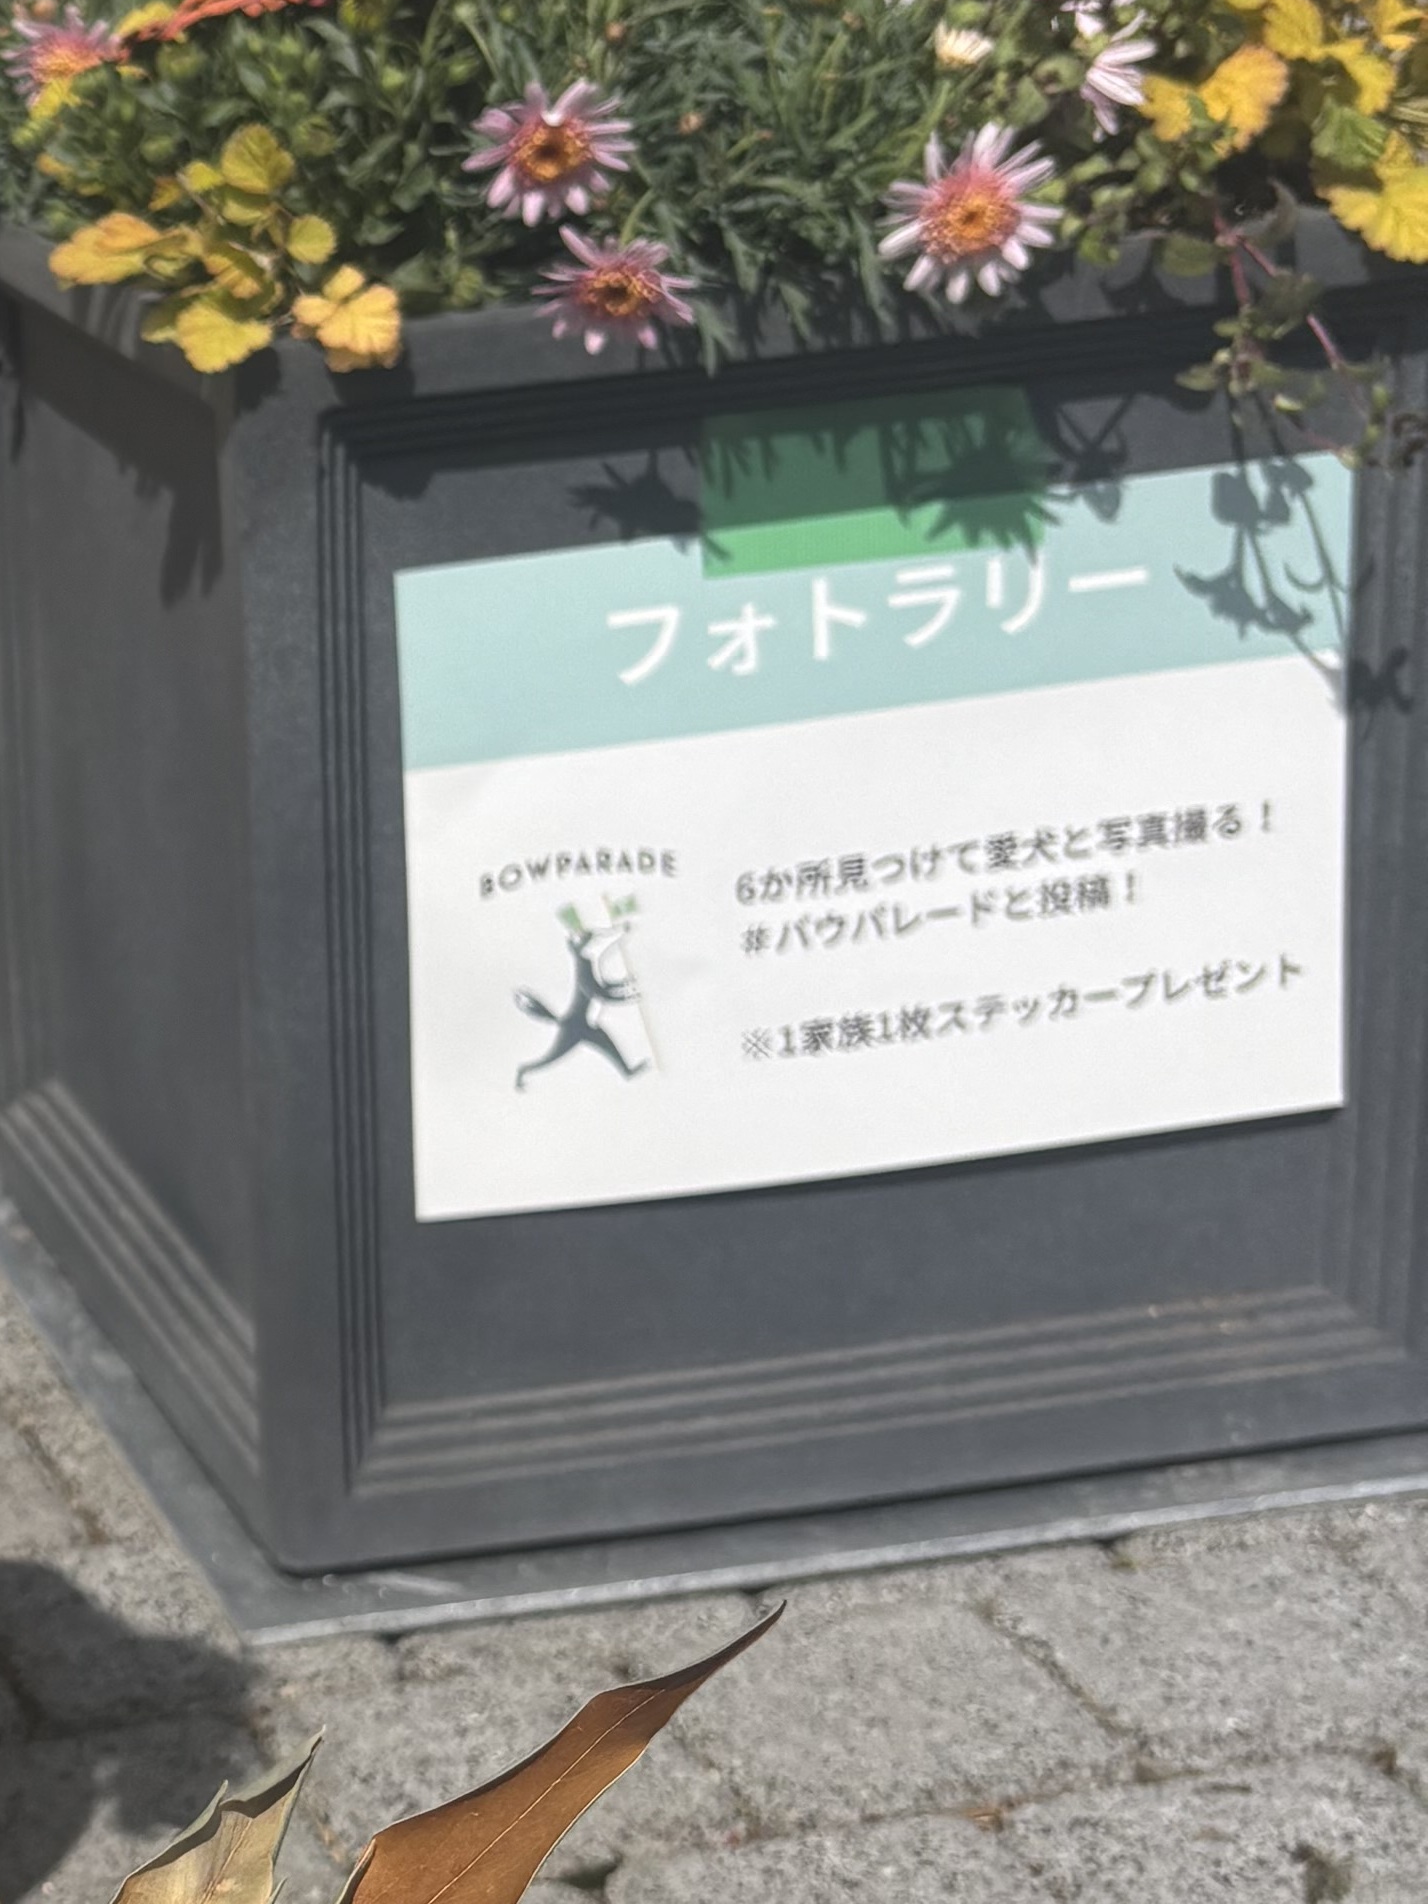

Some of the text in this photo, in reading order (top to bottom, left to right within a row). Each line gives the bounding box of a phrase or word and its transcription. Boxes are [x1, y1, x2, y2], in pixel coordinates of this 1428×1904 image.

[606, 550, 1149, 685] フォトラリー
[479, 847, 677, 899] BOWPARADE
